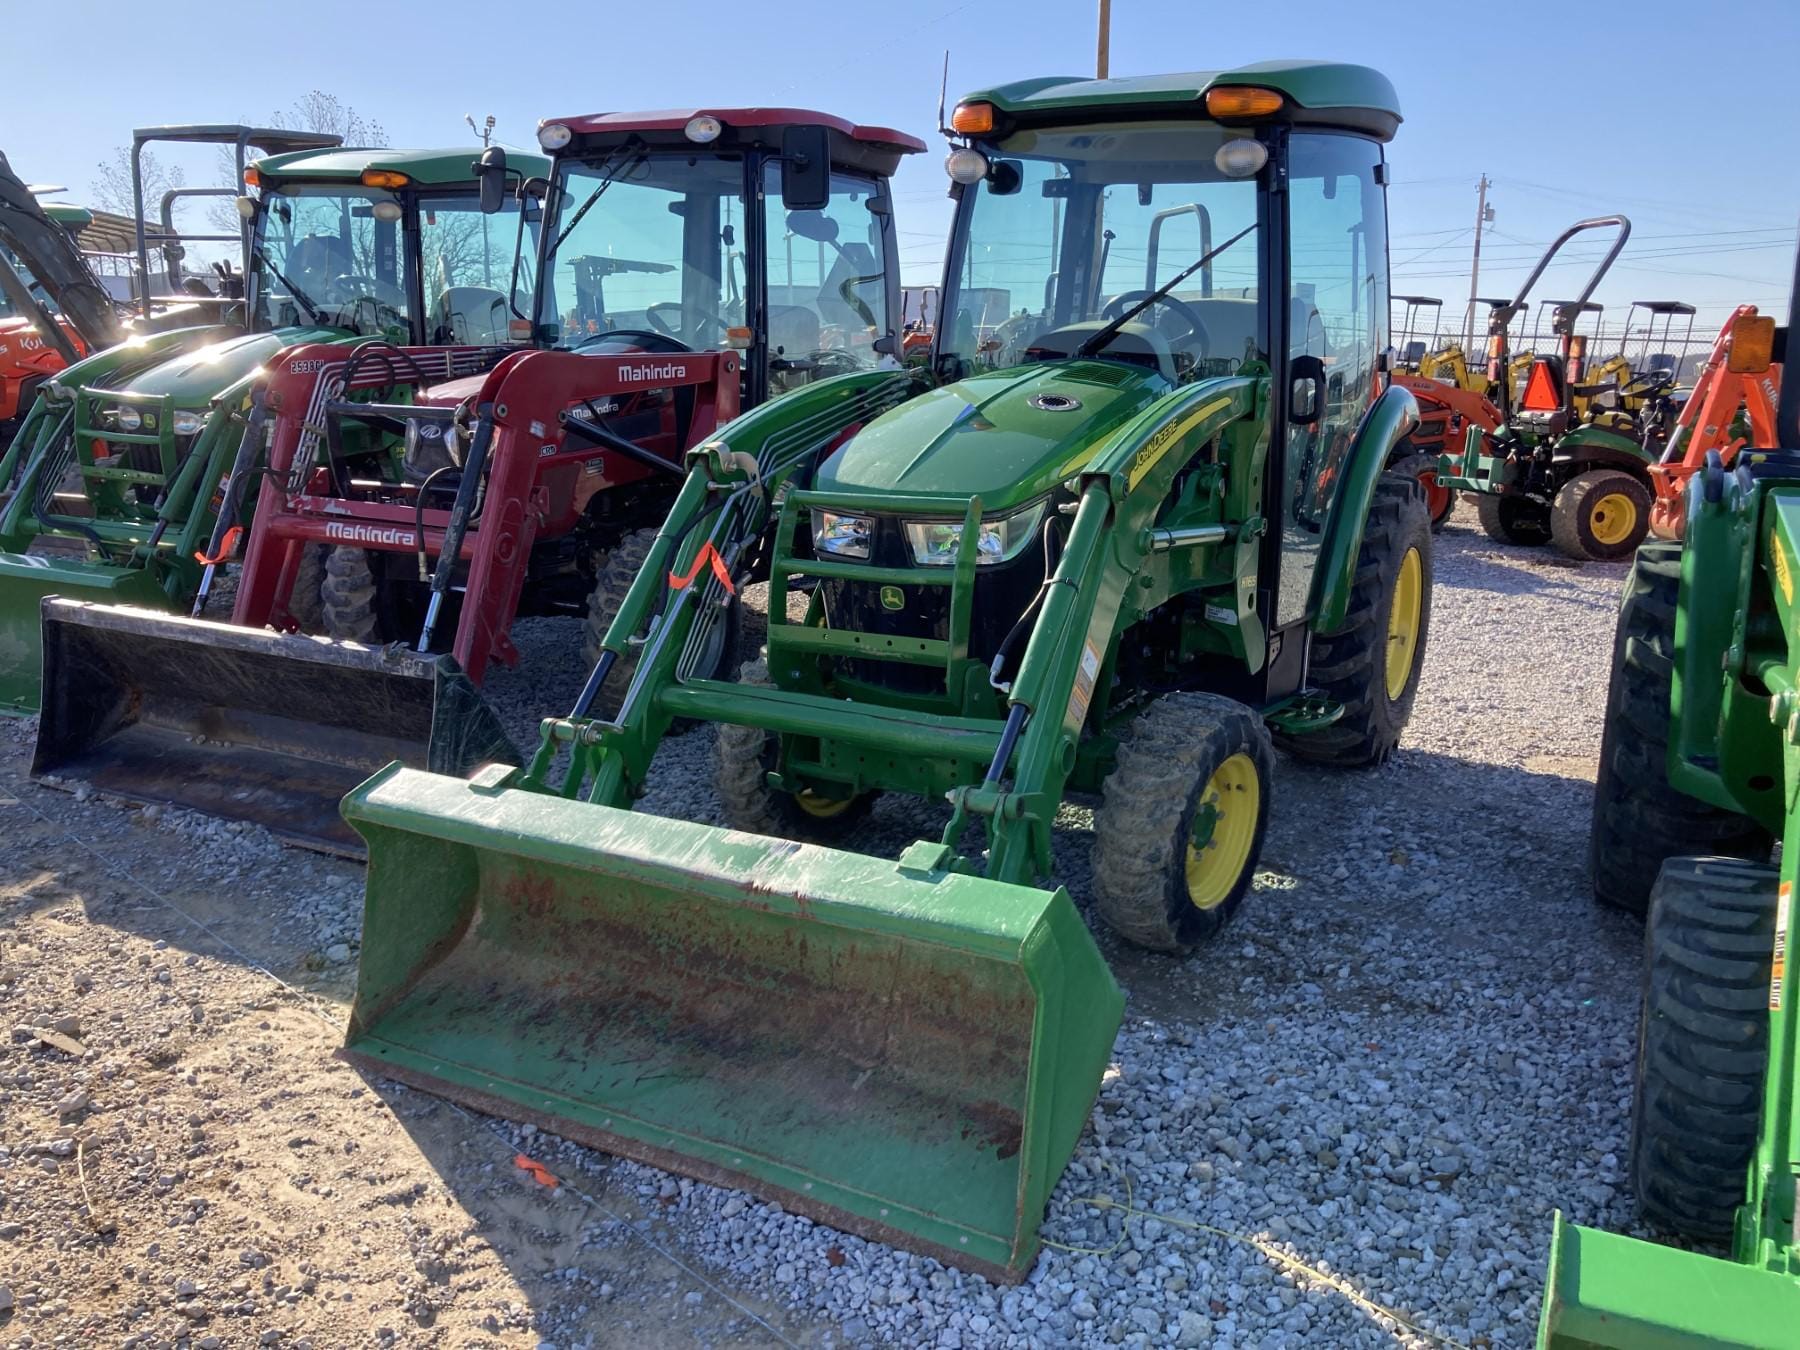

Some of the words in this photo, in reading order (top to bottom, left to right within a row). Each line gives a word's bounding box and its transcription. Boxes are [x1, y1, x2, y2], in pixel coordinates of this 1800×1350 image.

[618, 363, 686, 382] Mahindra
[1134, 442, 1154, 471] JOHN
[1153, 416, 1178, 451] DEERE
[326, 521, 415, 546] Mahindra
